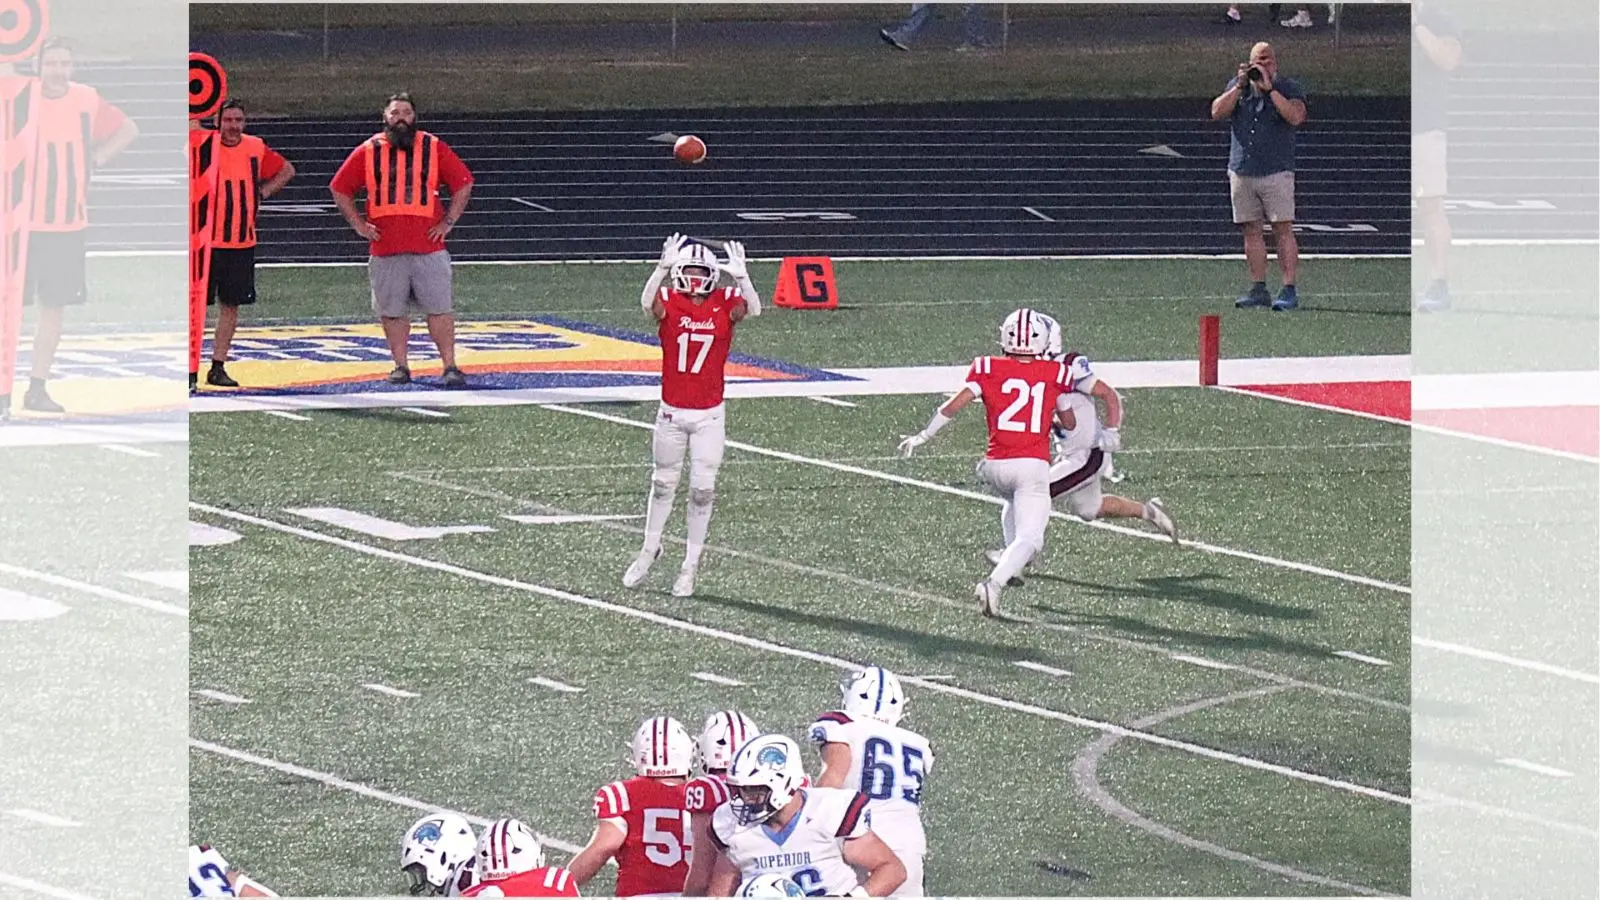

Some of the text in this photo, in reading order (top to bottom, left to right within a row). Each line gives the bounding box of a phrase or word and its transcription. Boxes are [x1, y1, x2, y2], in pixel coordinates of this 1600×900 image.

[795, 263, 829, 303] G
[678, 316, 716, 330] Rapids
[676, 332, 715, 374] 17
[997, 378, 1047, 434] 21
[861, 737, 923, 805] 65
[684, 786, 705, 810] 69
